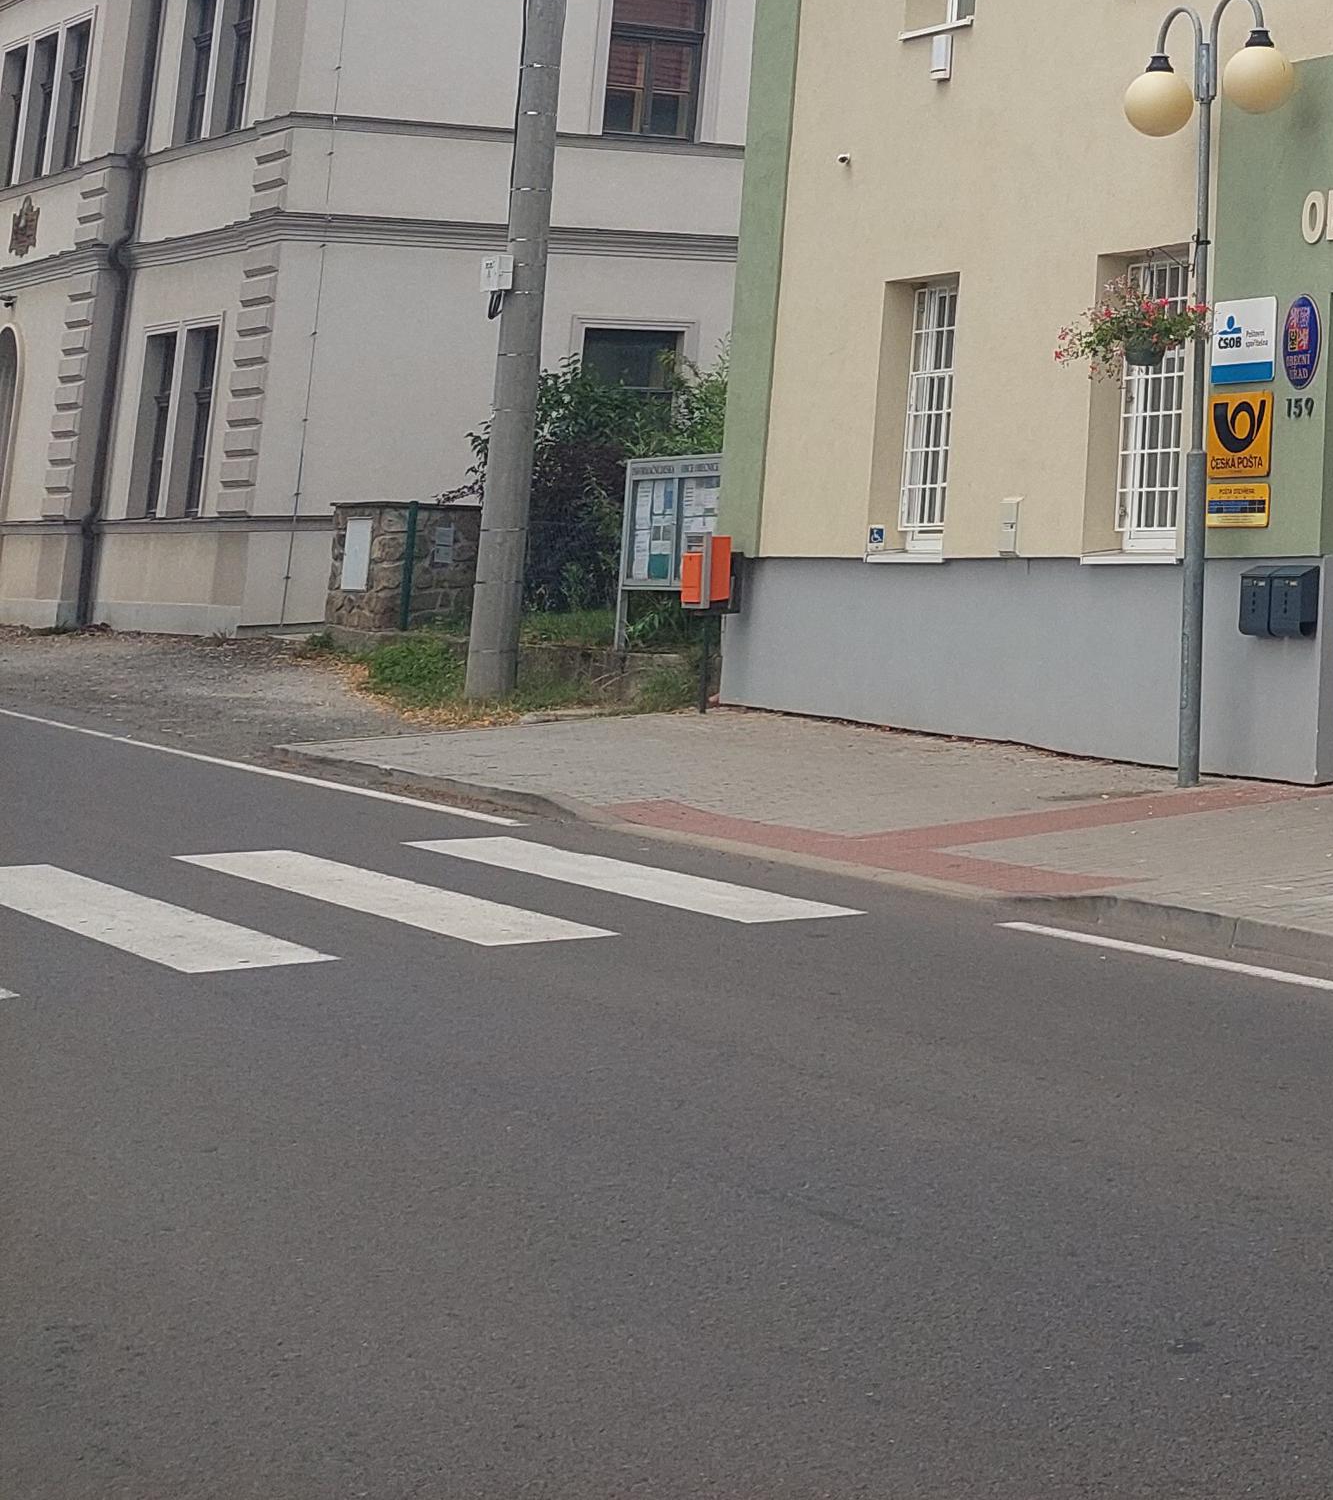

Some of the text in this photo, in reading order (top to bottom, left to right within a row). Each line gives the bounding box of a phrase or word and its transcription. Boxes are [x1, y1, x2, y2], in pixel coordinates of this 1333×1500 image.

[1286, 398, 1315, 418] 159
[1210, 453, 1263, 470] ČESKÁ POŠTA
